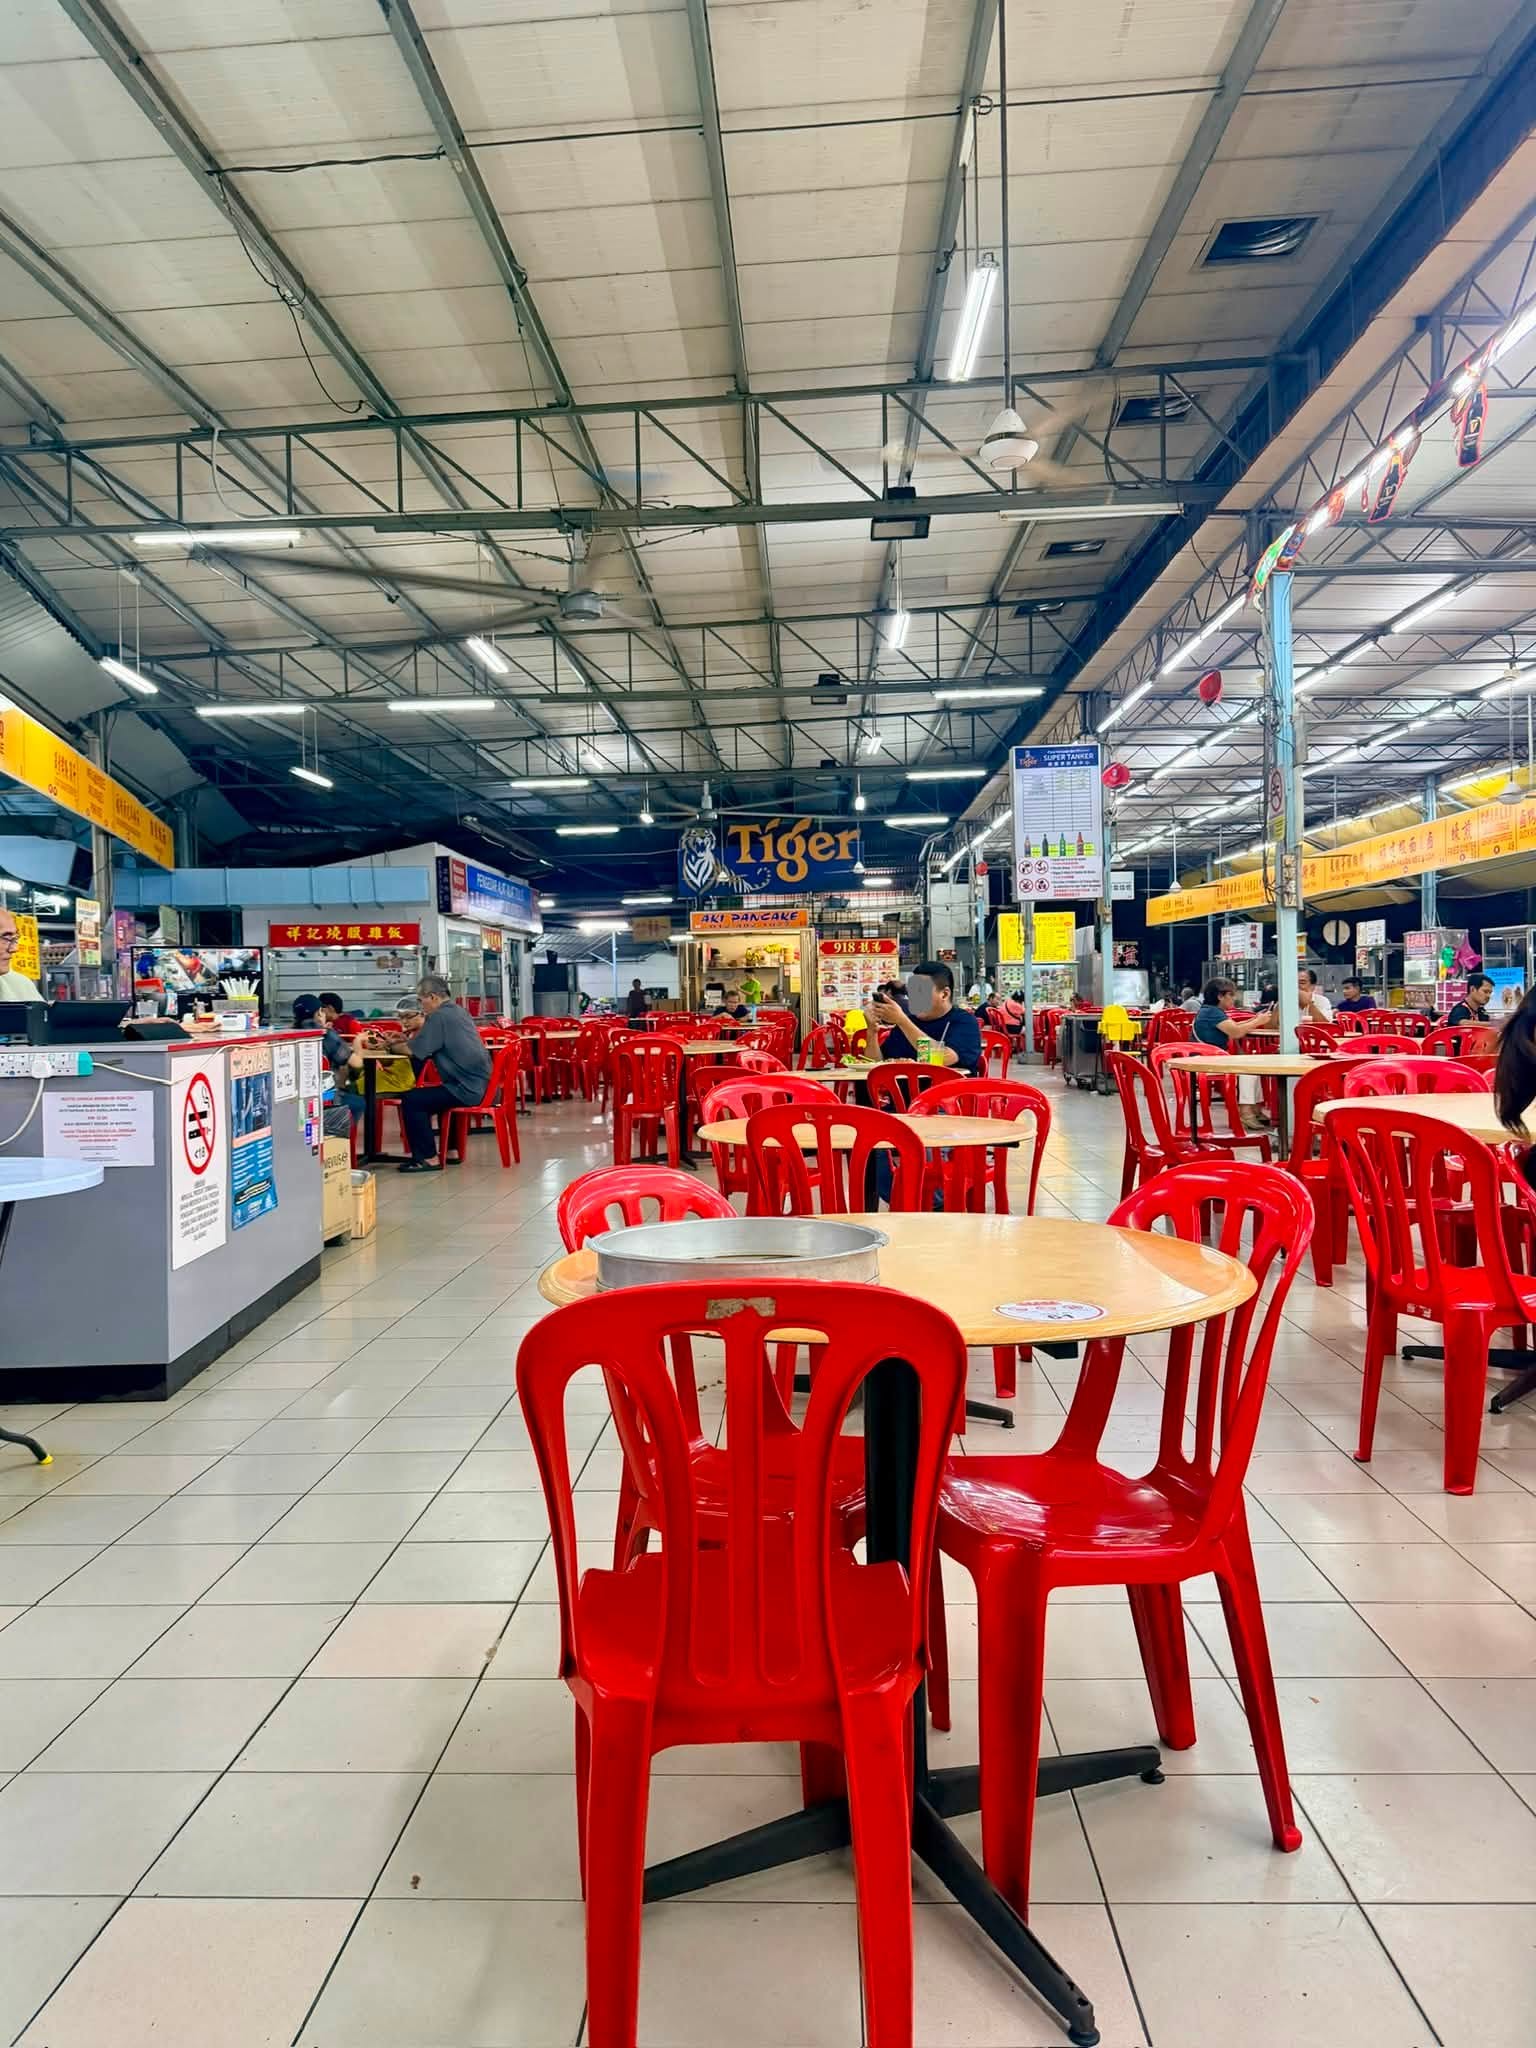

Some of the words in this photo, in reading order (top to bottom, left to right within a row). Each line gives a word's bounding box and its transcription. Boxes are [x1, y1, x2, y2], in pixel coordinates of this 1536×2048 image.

[1043, 753, 1066, 761] SUPER
[1067, 752, 1094, 760] TANKER
[728, 816, 860, 882] Tiger
[701, 913, 725, 923] AKI
[732, 911, 799, 922] PANCAKE
[833, 941, 856, 954] 918
